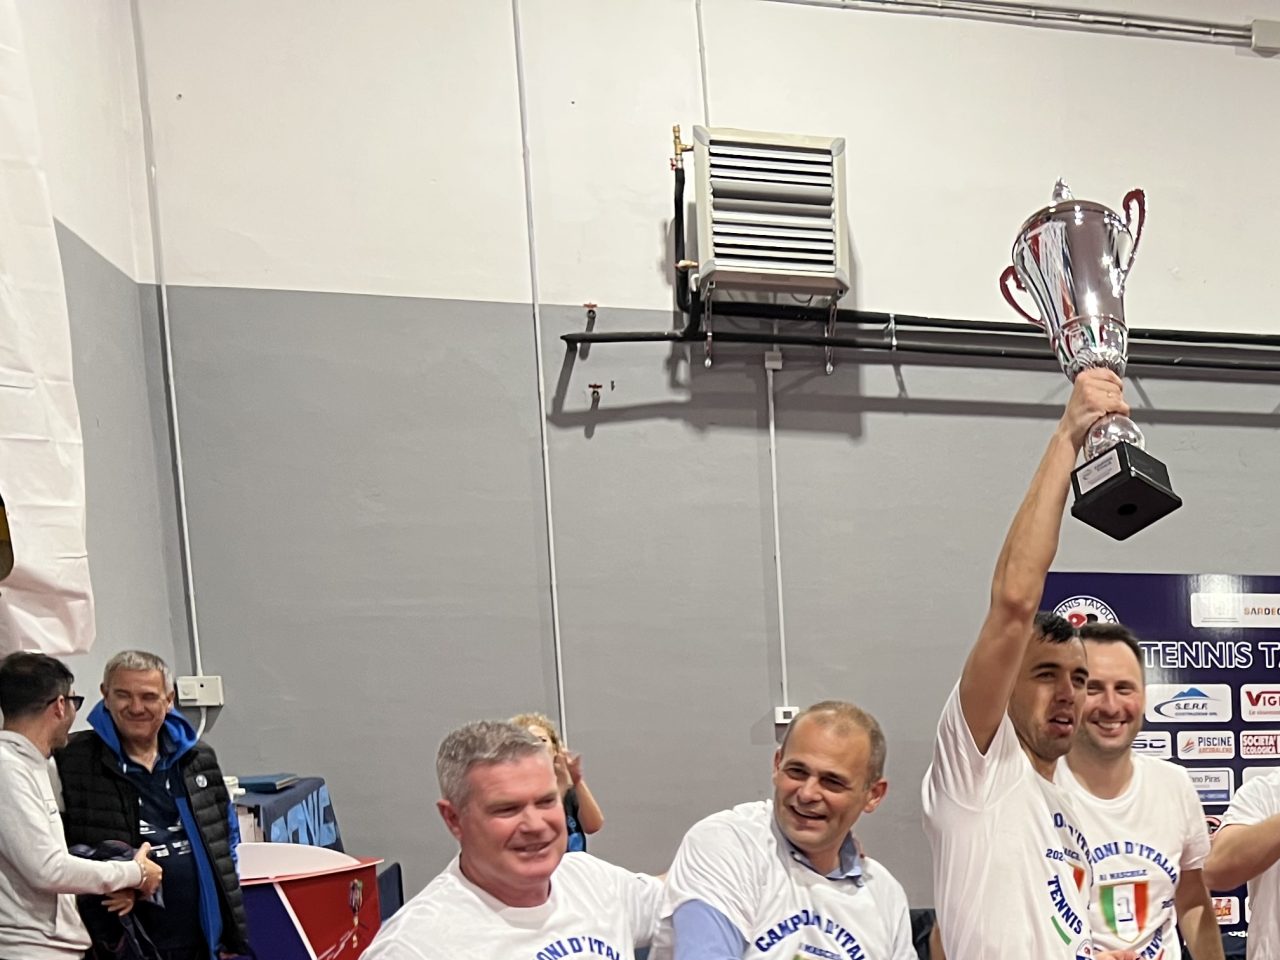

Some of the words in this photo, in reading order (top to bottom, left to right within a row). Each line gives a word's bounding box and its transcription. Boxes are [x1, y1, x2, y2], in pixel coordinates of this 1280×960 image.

[1138, 641, 1253, 669] TENNIS
[1198, 736, 1233, 747] PISCINE
[1045, 848, 1065, 862] 202
[1124, 841, 1179, 885] D'ITALIA
[1047, 874, 1083, 935] TENNIS
